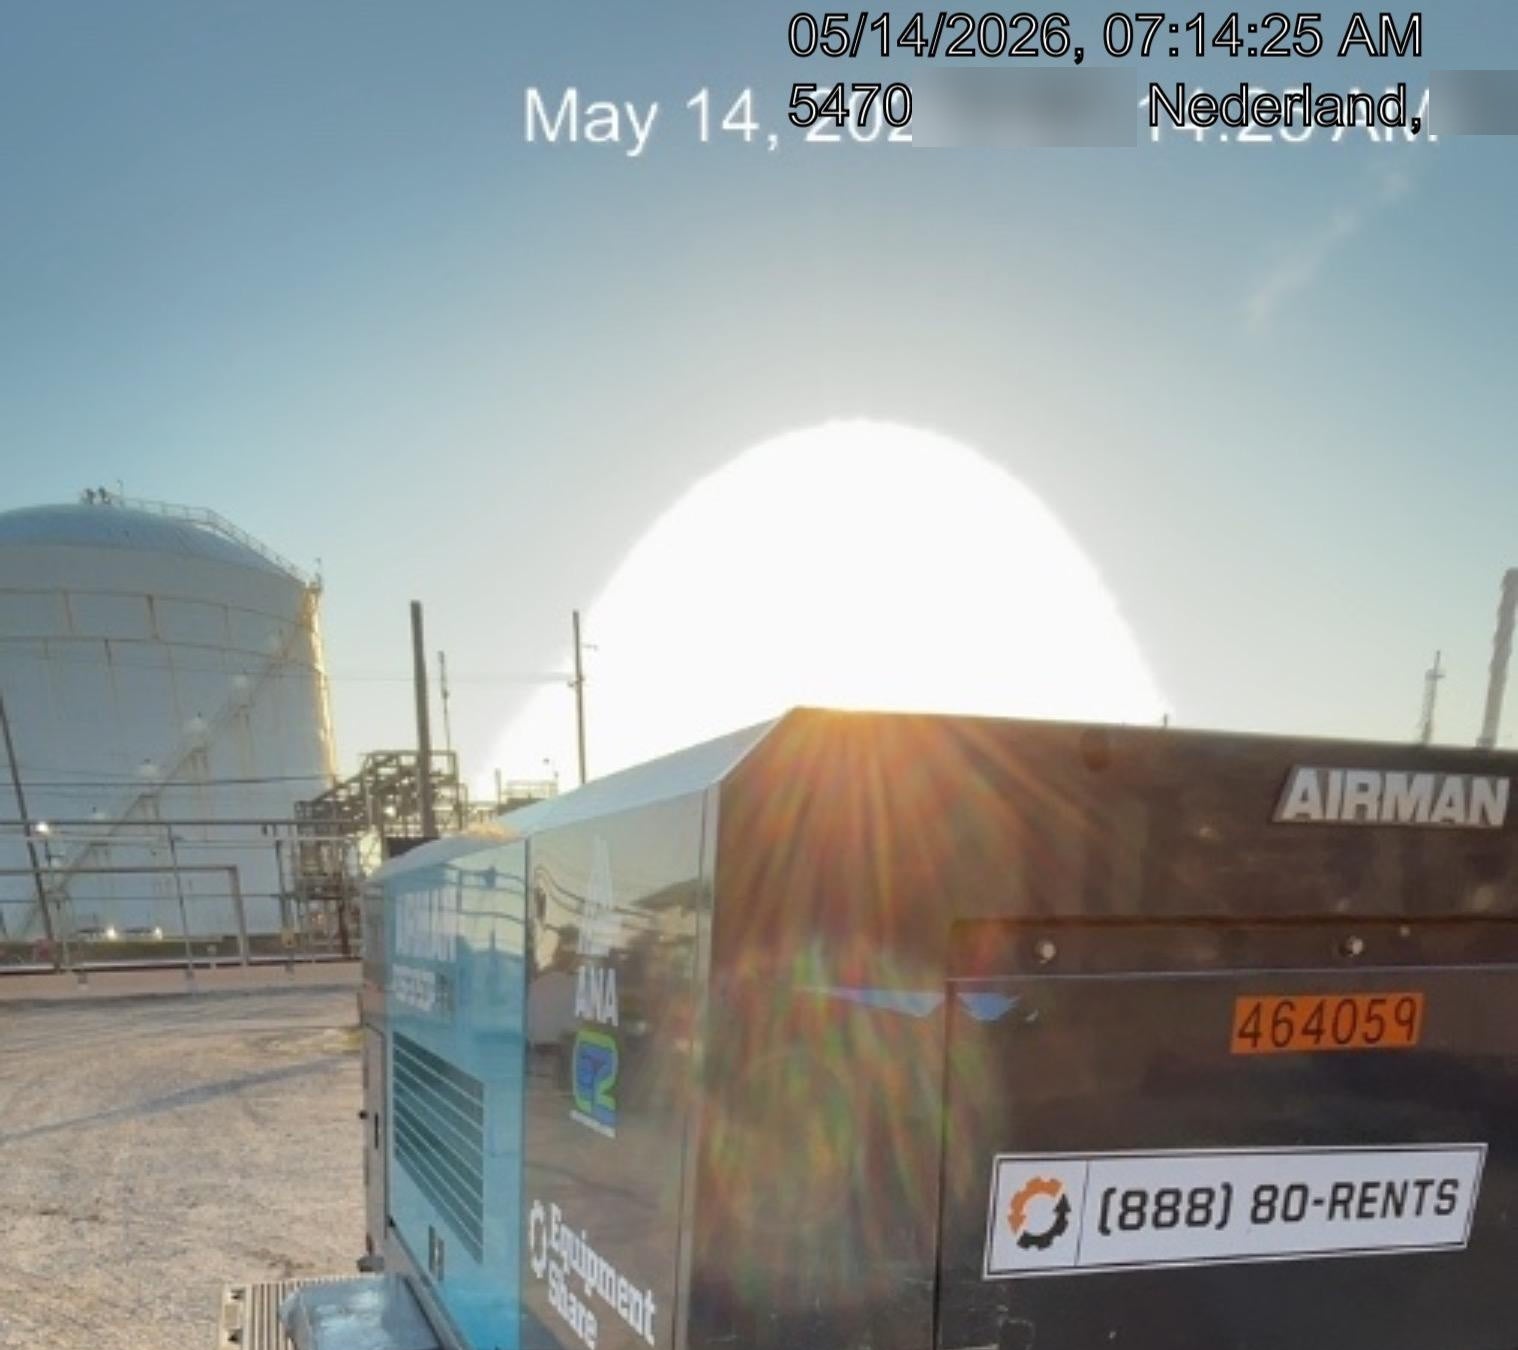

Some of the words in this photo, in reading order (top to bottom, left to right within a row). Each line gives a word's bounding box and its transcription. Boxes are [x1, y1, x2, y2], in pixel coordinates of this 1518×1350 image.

[1279, 767, 1510, 826] AIRMAN
[1237, 997, 1418, 1048] 464059
[1097, 1182, 1233, 1236] (888)
[1250, 1178, 1460, 1226] 80-RENTS
[550, 1202, 656, 1347] Equipment
